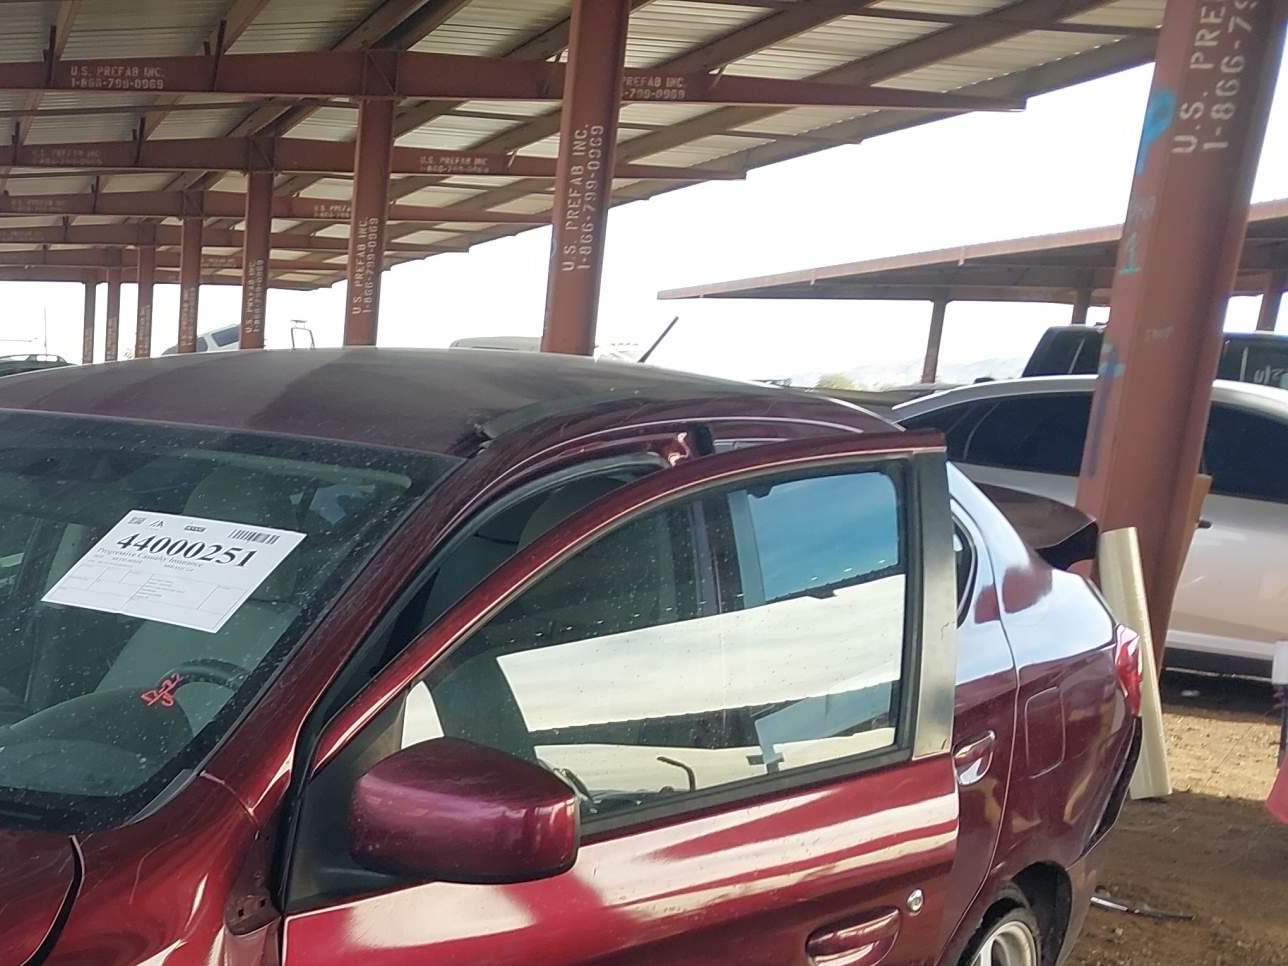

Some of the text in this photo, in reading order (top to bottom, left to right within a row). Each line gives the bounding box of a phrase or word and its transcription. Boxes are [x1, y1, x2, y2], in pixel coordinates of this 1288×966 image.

[96, 66, 139, 77] PREFAB
[572, 123, 590, 156] INC.
[565, 165, 584, 230] PREFAB
[575, 125, 604, 270] 1-866-799-0969
[117, 532, 257, 567] 44000251
